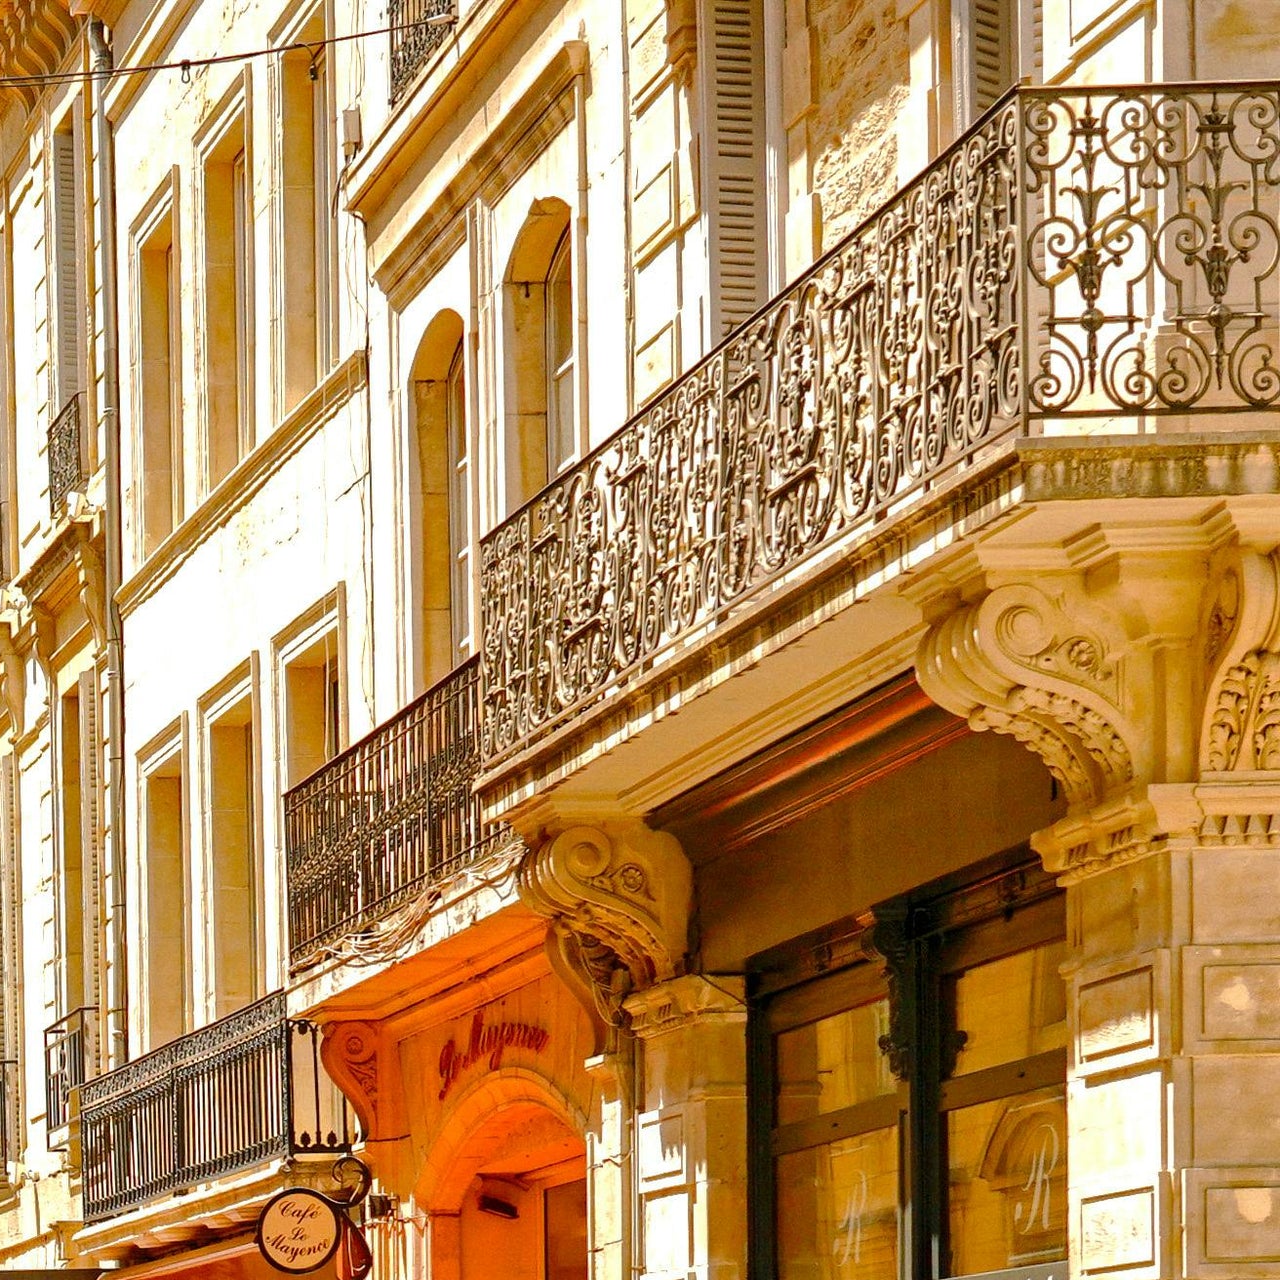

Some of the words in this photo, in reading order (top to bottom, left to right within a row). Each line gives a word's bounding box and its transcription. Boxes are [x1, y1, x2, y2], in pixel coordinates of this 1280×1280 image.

[278, 1200, 322, 1225] Café
[288, 1226, 310, 1241] Le
[265, 1234, 330, 1263] Mayence
